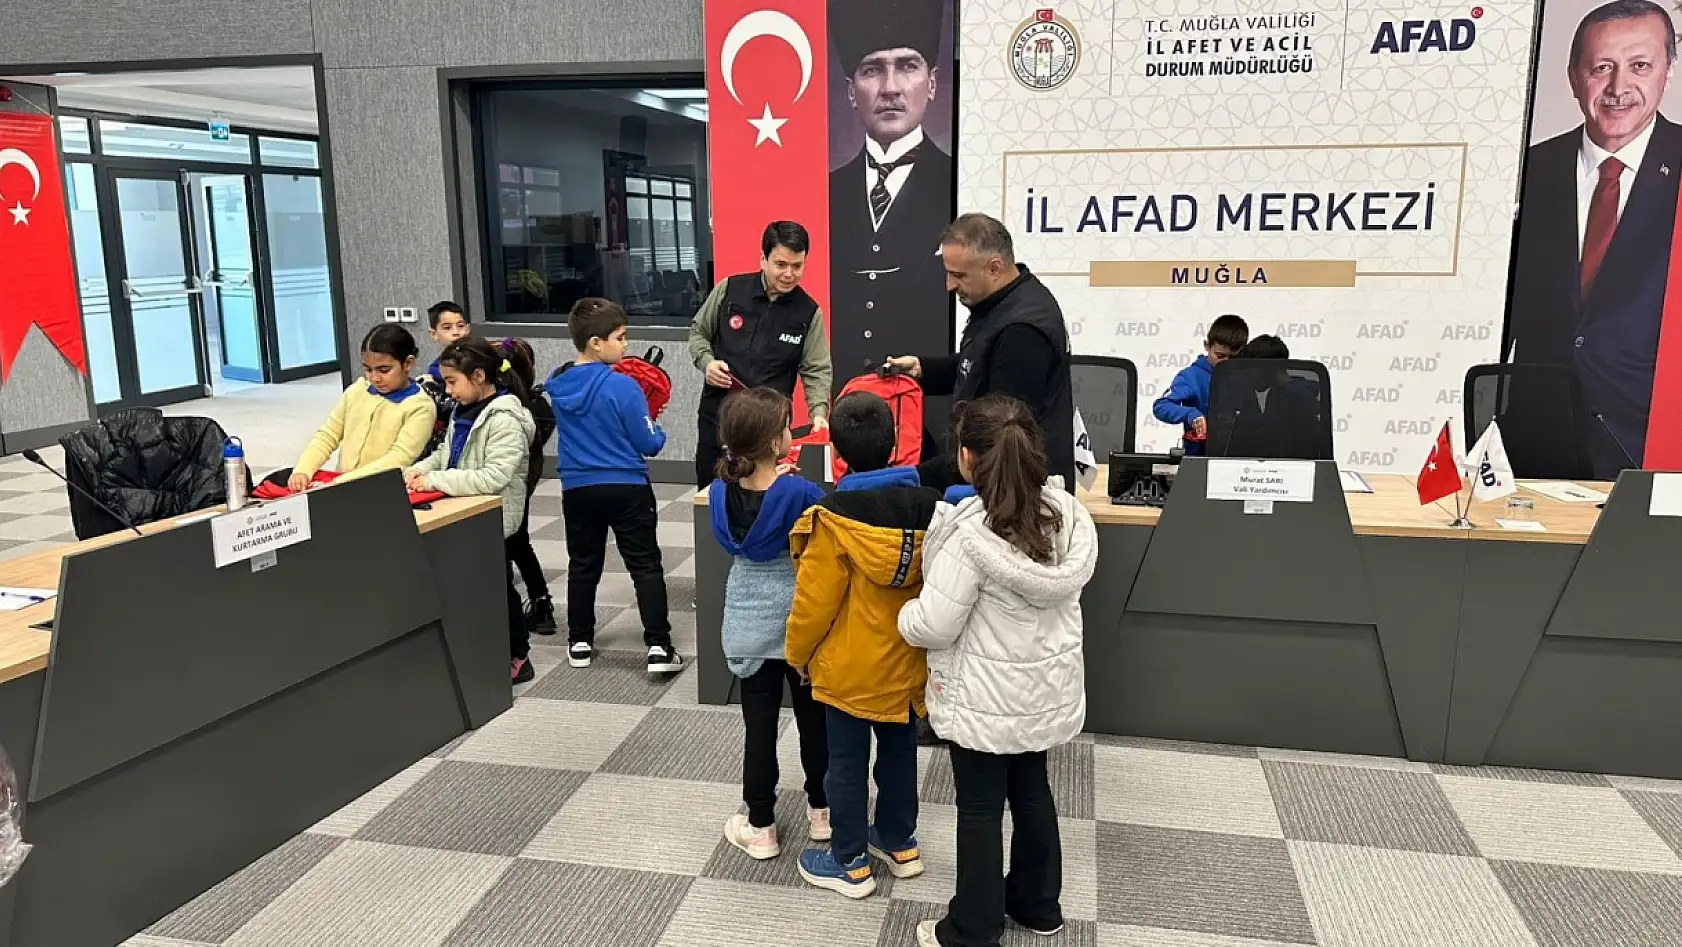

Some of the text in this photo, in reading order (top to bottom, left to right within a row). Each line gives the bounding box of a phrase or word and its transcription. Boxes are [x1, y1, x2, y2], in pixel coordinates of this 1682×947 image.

[1145, 12, 1316, 32] T.C. MUĞLA VALİLİĞİ
[1147, 32, 1313, 55] İL AFET VE ACİL
[1370, 18, 1476, 54] AFAD
[1145, 54, 1314, 77] DURUM MÜDÜRLÜĞÜ
[1025, 181, 1436, 233] İL AFAD MERKEZİ
[1171, 263, 1268, 284] MUĞLA
[1115, 322, 1160, 337] AFAD
[1275, 323, 1322, 338] AFAD
[1356, 323, 1406, 339] AFAD
[1440, 325, 1491, 341] AFAD
[779, 333, 802, 344] AFAD
[1146, 353, 1191, 368] AFAD
[1389, 356, 1438, 372] AFAD
[1352, 387, 1401, 403] AFAD
[1384, 420, 1432, 435] AFAD
[1347, 450, 1395, 466] AFAD
